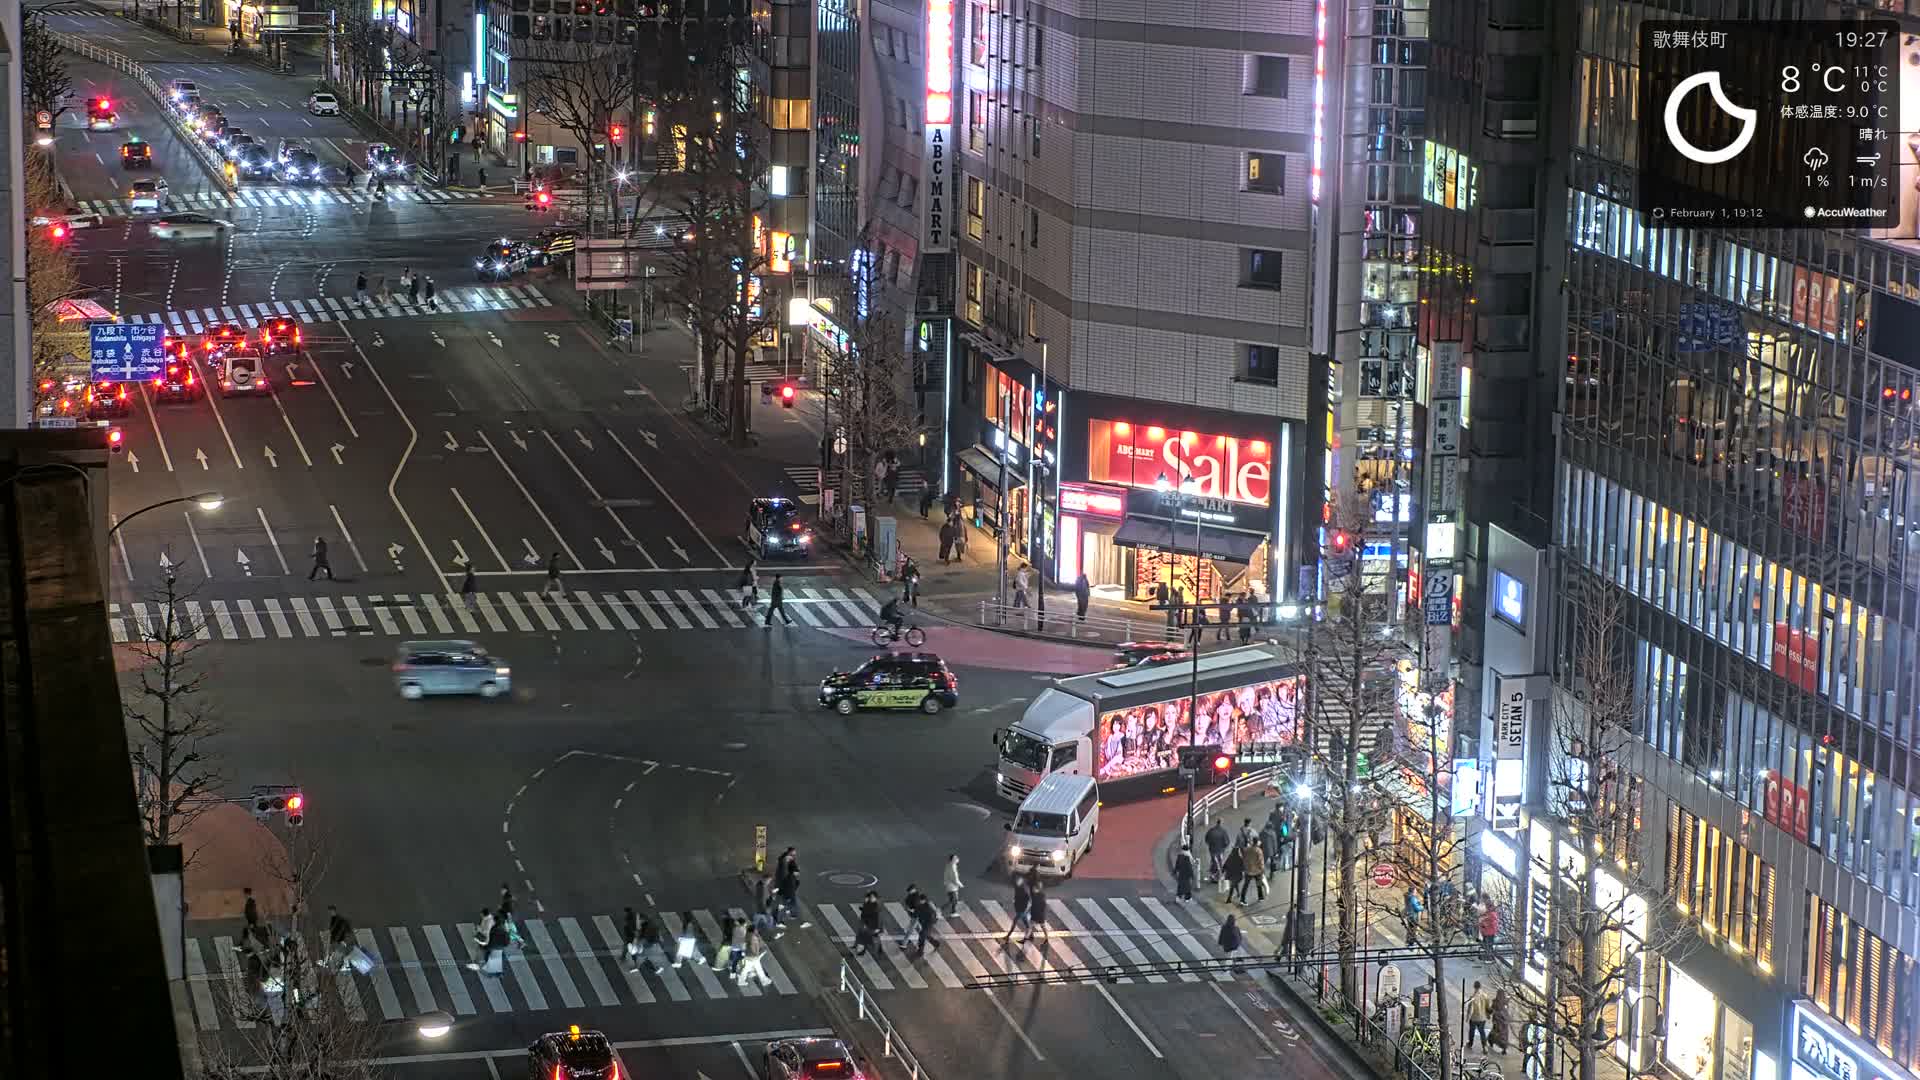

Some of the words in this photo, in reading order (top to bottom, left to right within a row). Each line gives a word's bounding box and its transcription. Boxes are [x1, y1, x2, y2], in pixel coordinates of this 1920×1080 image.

[97, 326, 125, 335] 九段下
[1162, 437, 1269, 505] Sale
[1436, 514, 1447, 522] 7F
[1512, 692, 1524, 702] 5
[1502, 702, 1510, 720] CITY
[1501, 722, 1509, 740] PARK
[1510, 706, 1522, 746] ISETAN
